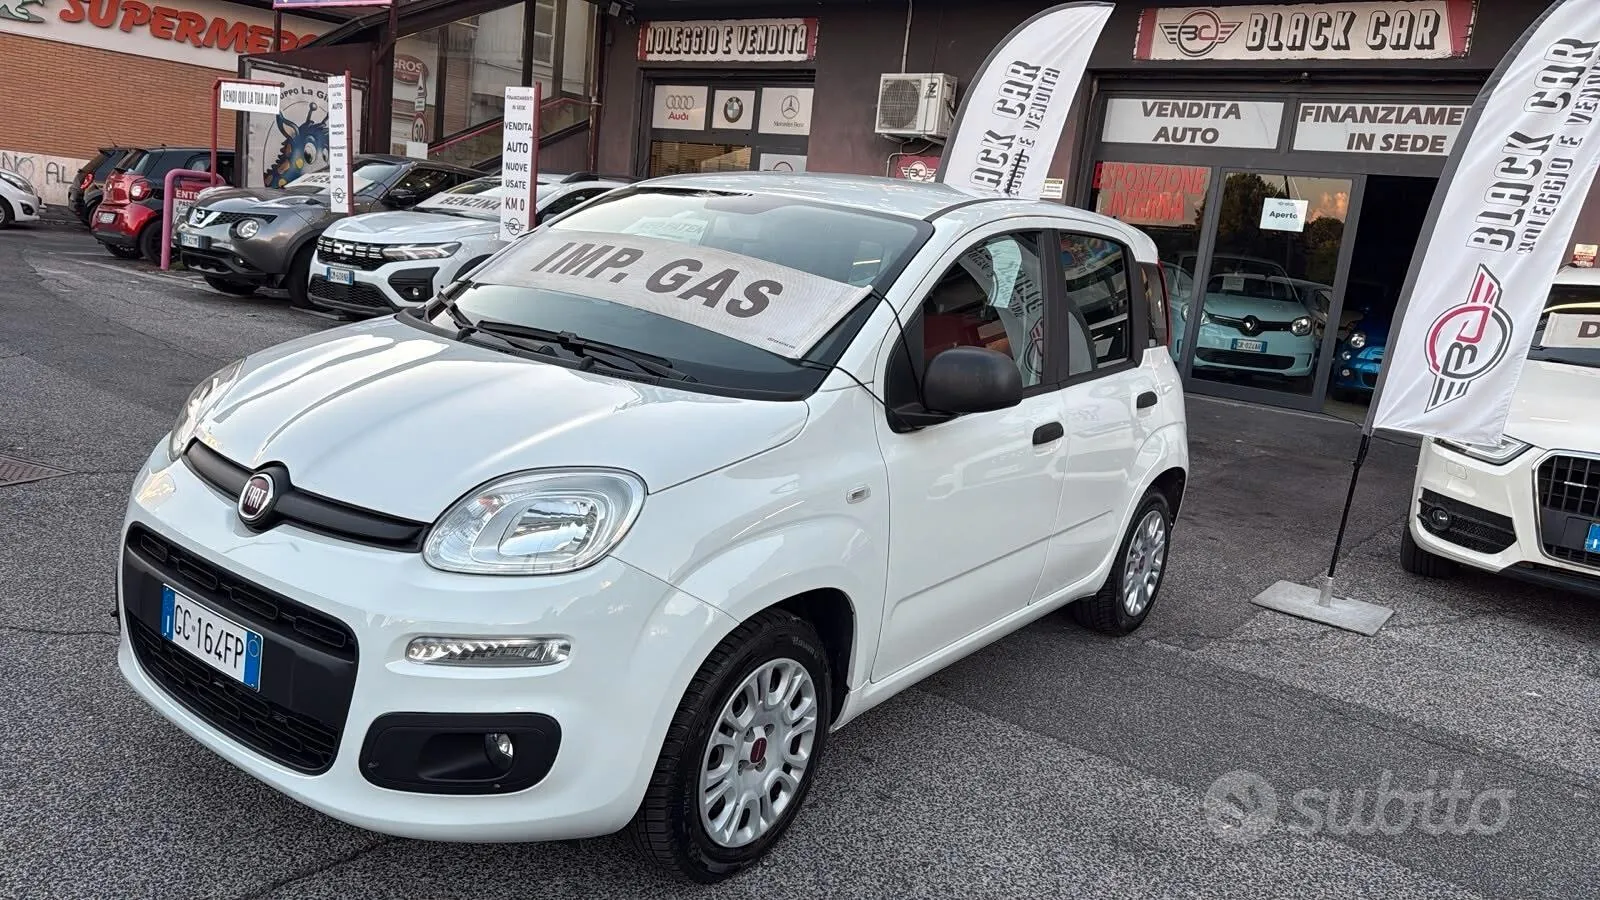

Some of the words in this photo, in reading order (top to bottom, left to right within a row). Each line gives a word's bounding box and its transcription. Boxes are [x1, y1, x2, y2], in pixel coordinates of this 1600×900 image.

[645, 25, 720, 54] NOLEGGIO
[723, 25, 734, 54] E
[737, 24, 809, 54] VENDITA
[1246, 11, 1357, 51] BLACK
[1366, 9, 1441, 50] CAR
[301, 86, 314, 96] La
[316, 90, 329, 102] Gi
[992, 60, 1042, 120] CAR
[1023, 67, 1061, 131] VENDITA
[668, 111, 689, 121] Audi
[1142, 101, 1241, 120] VENDITA
[1299, 105, 1472, 126] FINANZIAME
[505, 121, 532, 131] VENDITA
[1152, 126, 1220, 144] AUTO
[507, 141, 528, 153] AUTO
[1347, 132, 1376, 151] IN
[1380, 133, 1447, 153] SEDE
[1466, 130, 1555, 252] BLACK
[1523, 38, 1600, 114] CAR
[505, 162, 528, 172] NUOVE
[505, 180, 526, 190] USATE
[176, 189, 200, 200] ENTR
[440, 196, 502, 210] BENZINA
[505, 197, 518, 211] KM
[1516, 157, 1574, 255] NOLEGGIO
[1269, 210, 1298, 220] Aperto
[530, 242, 645, 284] IMP.
[646, 258, 784, 318] GAS
[1578, 321, 1600, 338] D
[244, 485, 268, 509] FIAT
